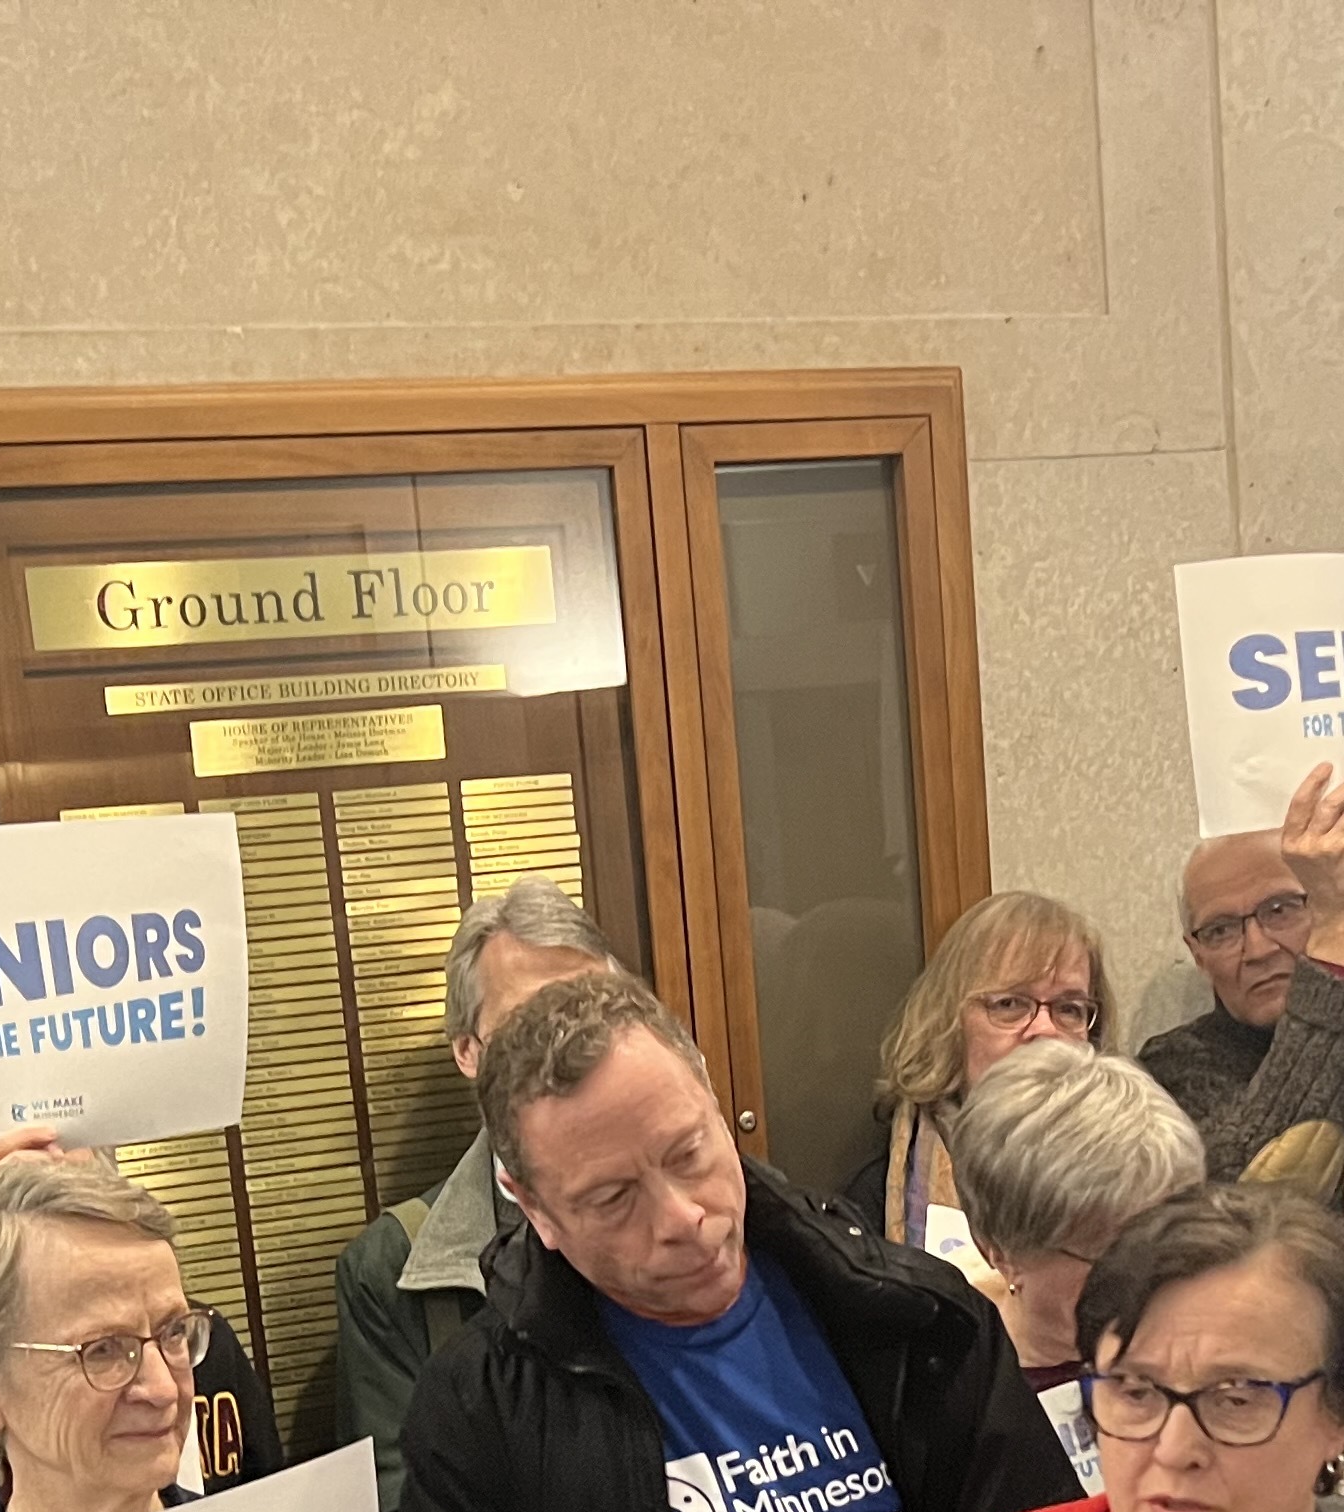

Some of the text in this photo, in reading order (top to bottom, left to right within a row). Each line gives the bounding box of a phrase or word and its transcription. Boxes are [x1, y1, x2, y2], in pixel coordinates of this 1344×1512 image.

[97, 566, 496, 631] Ground Floor
[134, 671, 479, 707] STATE OFFICE BUILDING DIRECTORY
[223, 713, 413, 737] HOUSE OF REPRESENTATIVES
[1303, 715, 1333, 738] FOR
[29, 986, 206, 1053] FUTURE!
[716, 1426, 859, 1494] Faith in
